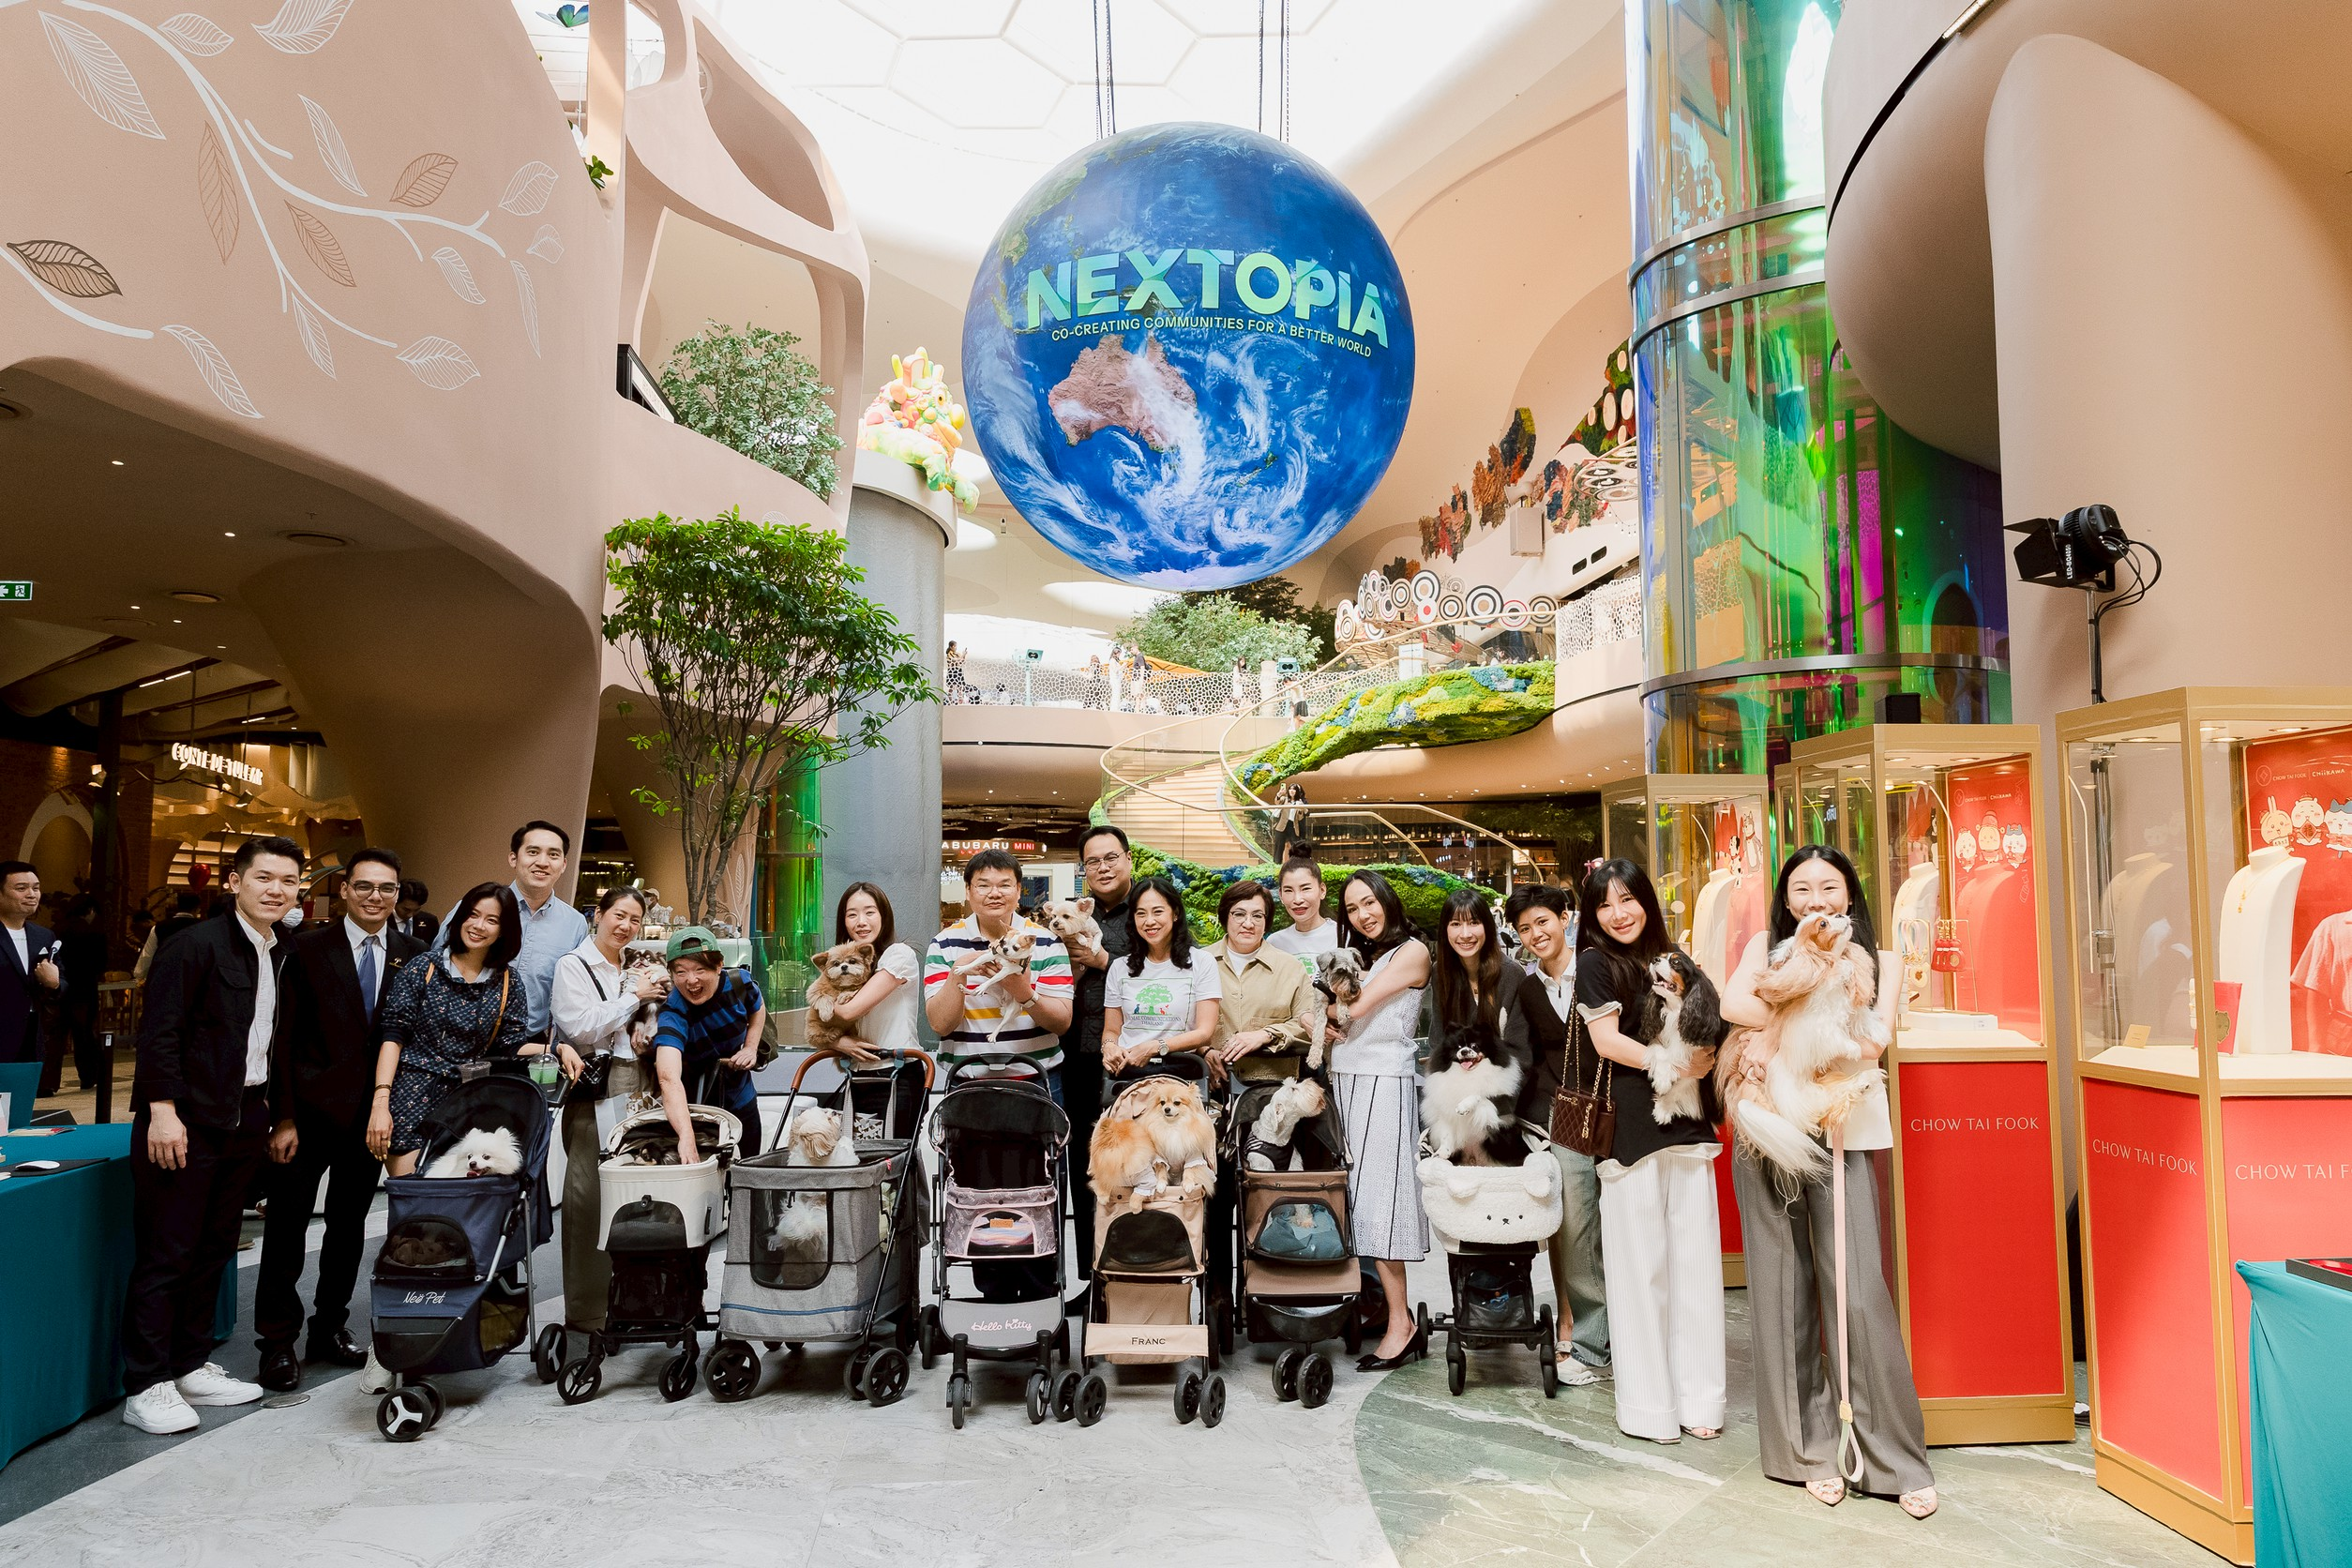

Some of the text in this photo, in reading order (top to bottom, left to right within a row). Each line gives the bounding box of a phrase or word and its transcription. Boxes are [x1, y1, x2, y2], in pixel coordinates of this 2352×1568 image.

[1027, 249, 1389, 348] NEXTOPIA
[1051, 316, 1372, 358] CO-CREATING COMMUNITIES FOR A BETTER WORLD
[1910, 1117, 2040, 1132] CHOW TAI FOOK
[2092, 1138, 2197, 1175] CHOW TAI FOOK
[2235, 1164, 2298, 1180] CHOW
[2302, 1164, 2332, 1179] TAI
[403, 1291, 446, 1304] Neo Pet
[971, 1319, 1033, 1331] Hello Kitty
